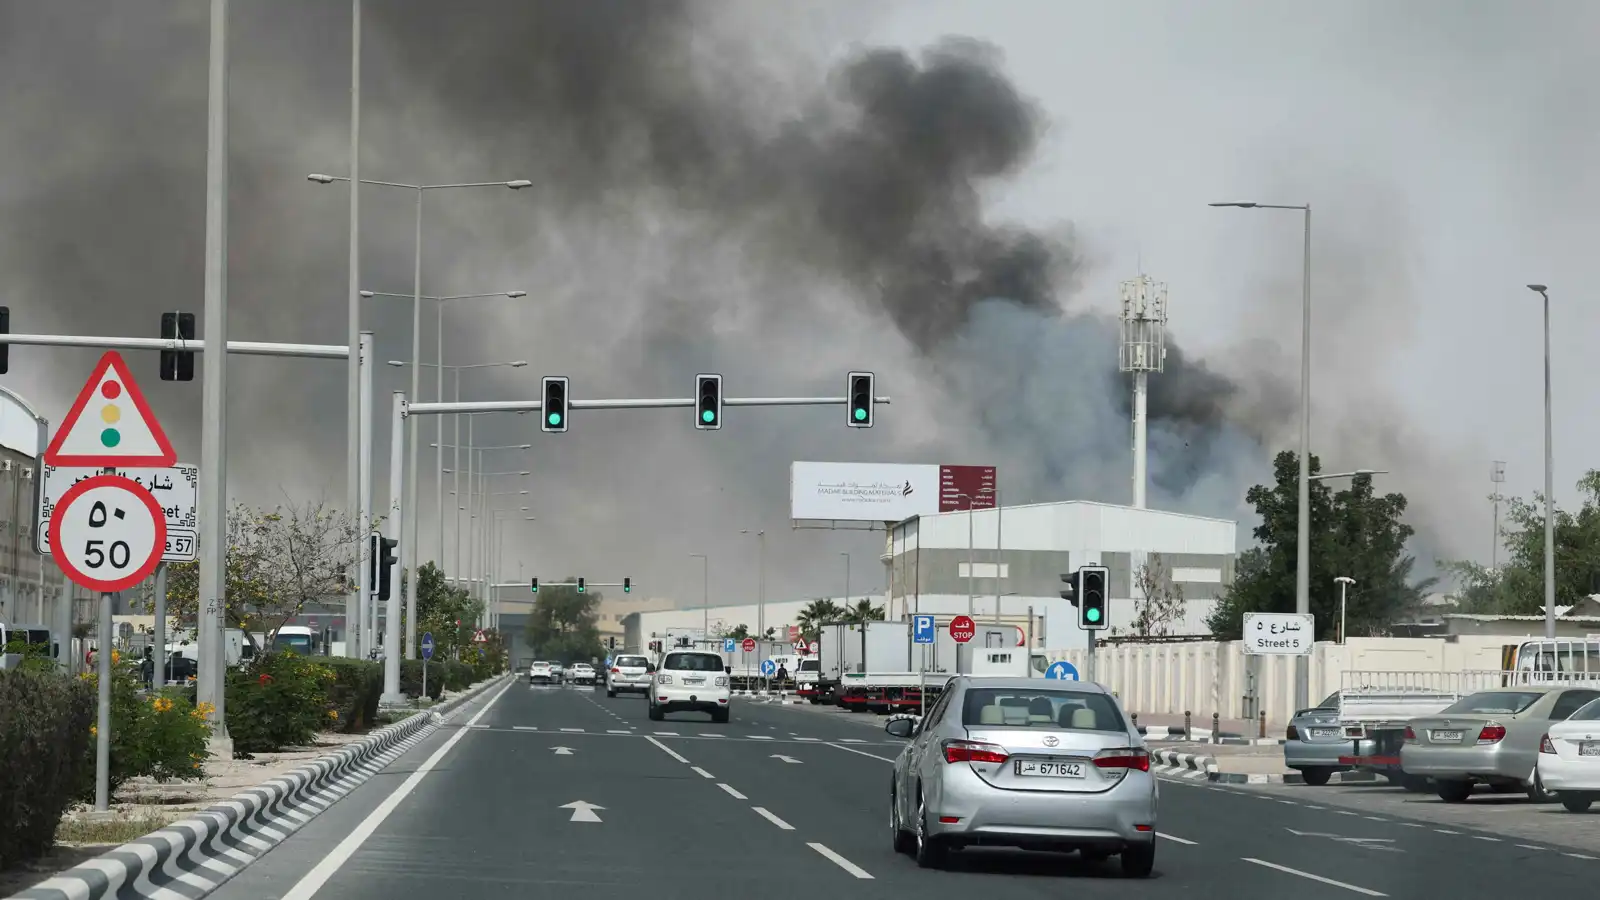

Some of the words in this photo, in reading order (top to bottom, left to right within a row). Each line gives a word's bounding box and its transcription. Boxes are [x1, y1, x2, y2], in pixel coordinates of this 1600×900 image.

[175, 538, 191, 553] 57
[84, 539, 131, 569] 50
[917, 617, 931, 635] P
[1270, 621, 1301, 634] شارع
[953, 631, 973, 639] STOP
[726, 639, 734, 649] P
[1257, 638, 1290, 648] Street
[1292, 638, 1300, 648] 5
[1040, 763, 1080, 776] 671642
